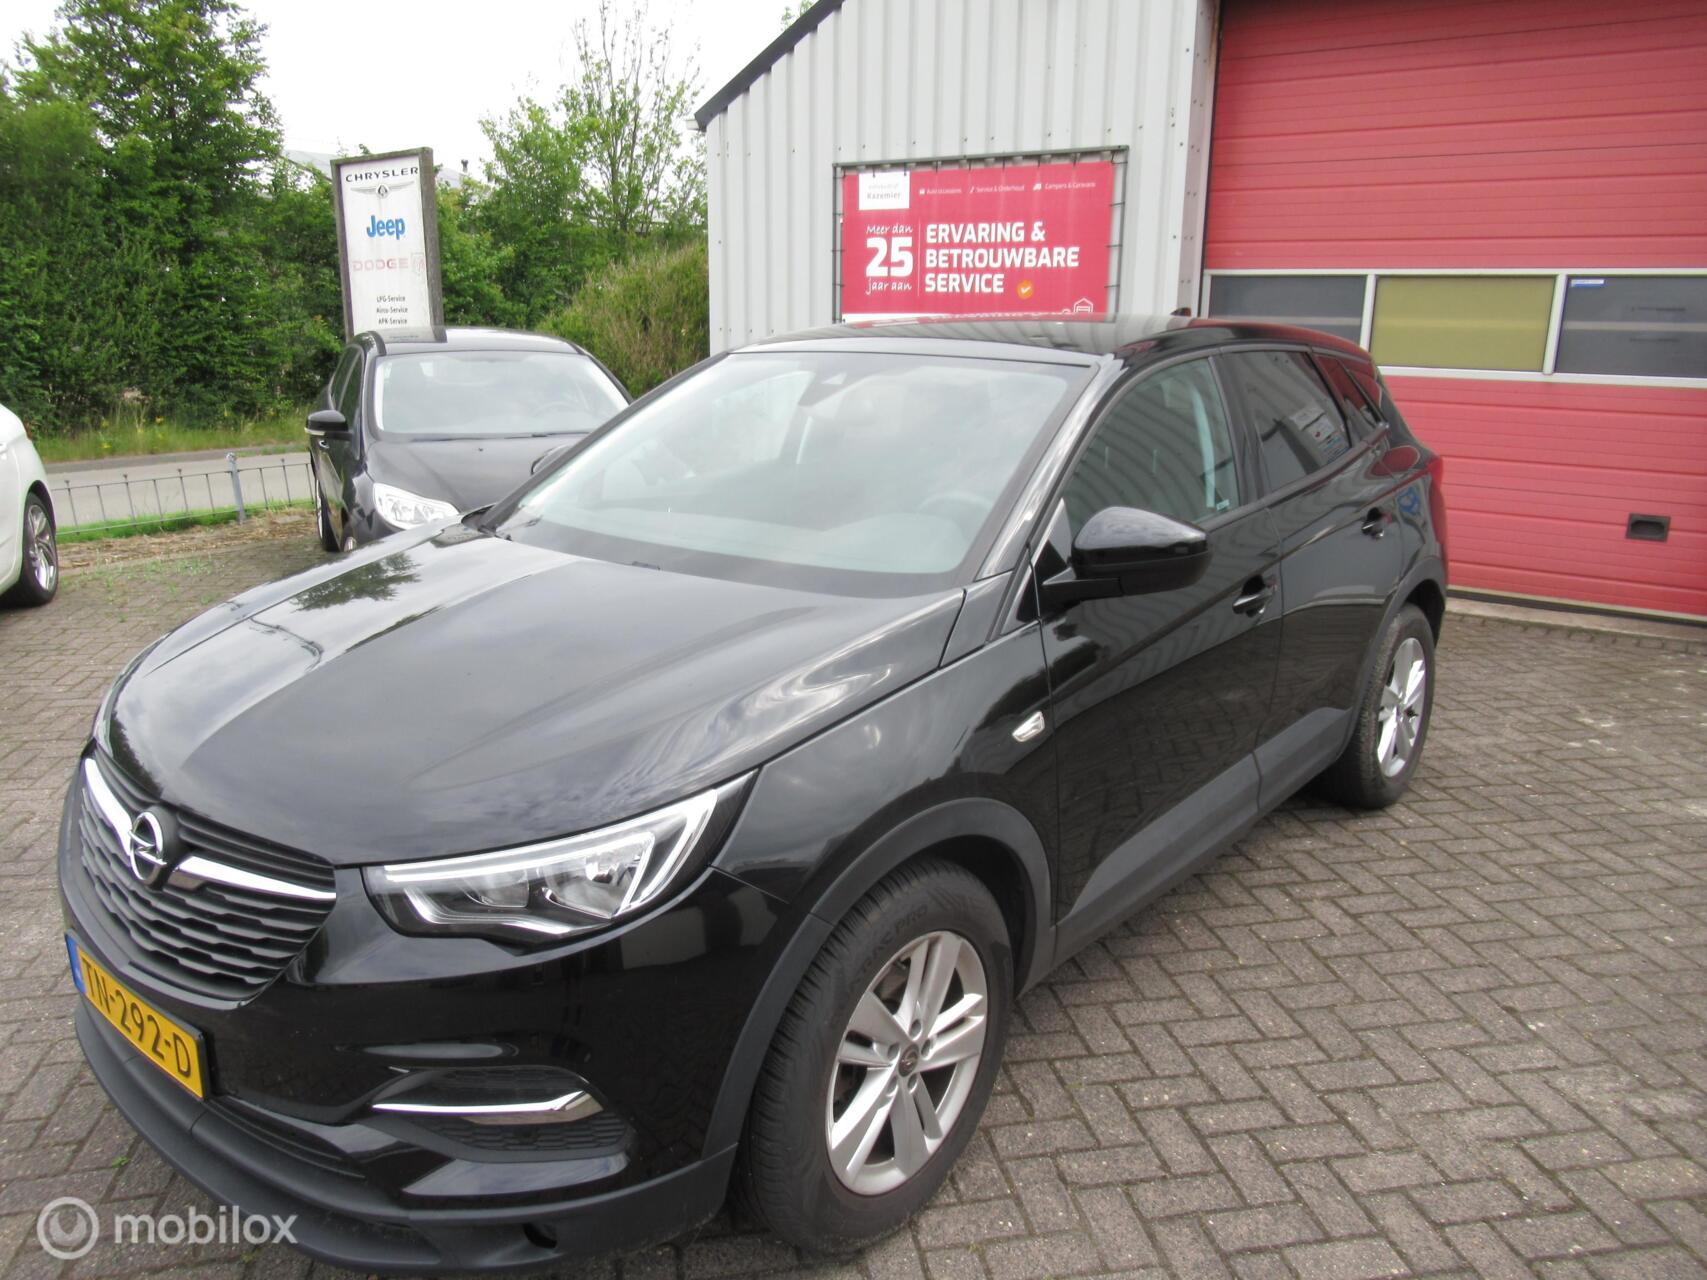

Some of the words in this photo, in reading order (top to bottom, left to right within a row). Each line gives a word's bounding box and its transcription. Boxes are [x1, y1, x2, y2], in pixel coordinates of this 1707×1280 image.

[345, 167, 418, 182] CHRYSLER
[366, 215, 405, 240] Jeep
[866, 224, 889, 235] Meer
[891, 223, 913, 234] dan
[926, 222, 1025, 243] ERVARING
[1031, 221, 1046, 242] &
[352, 258, 408, 272] DODGE
[866, 236, 914, 278] 25
[925, 247, 1080, 268] BETROUWBARE
[866, 278, 889, 295] jaar
[891, 282, 912, 292] aan
[925, 273, 1005, 293] SERVICE
[81, 957, 192, 1078] TN-292-D
